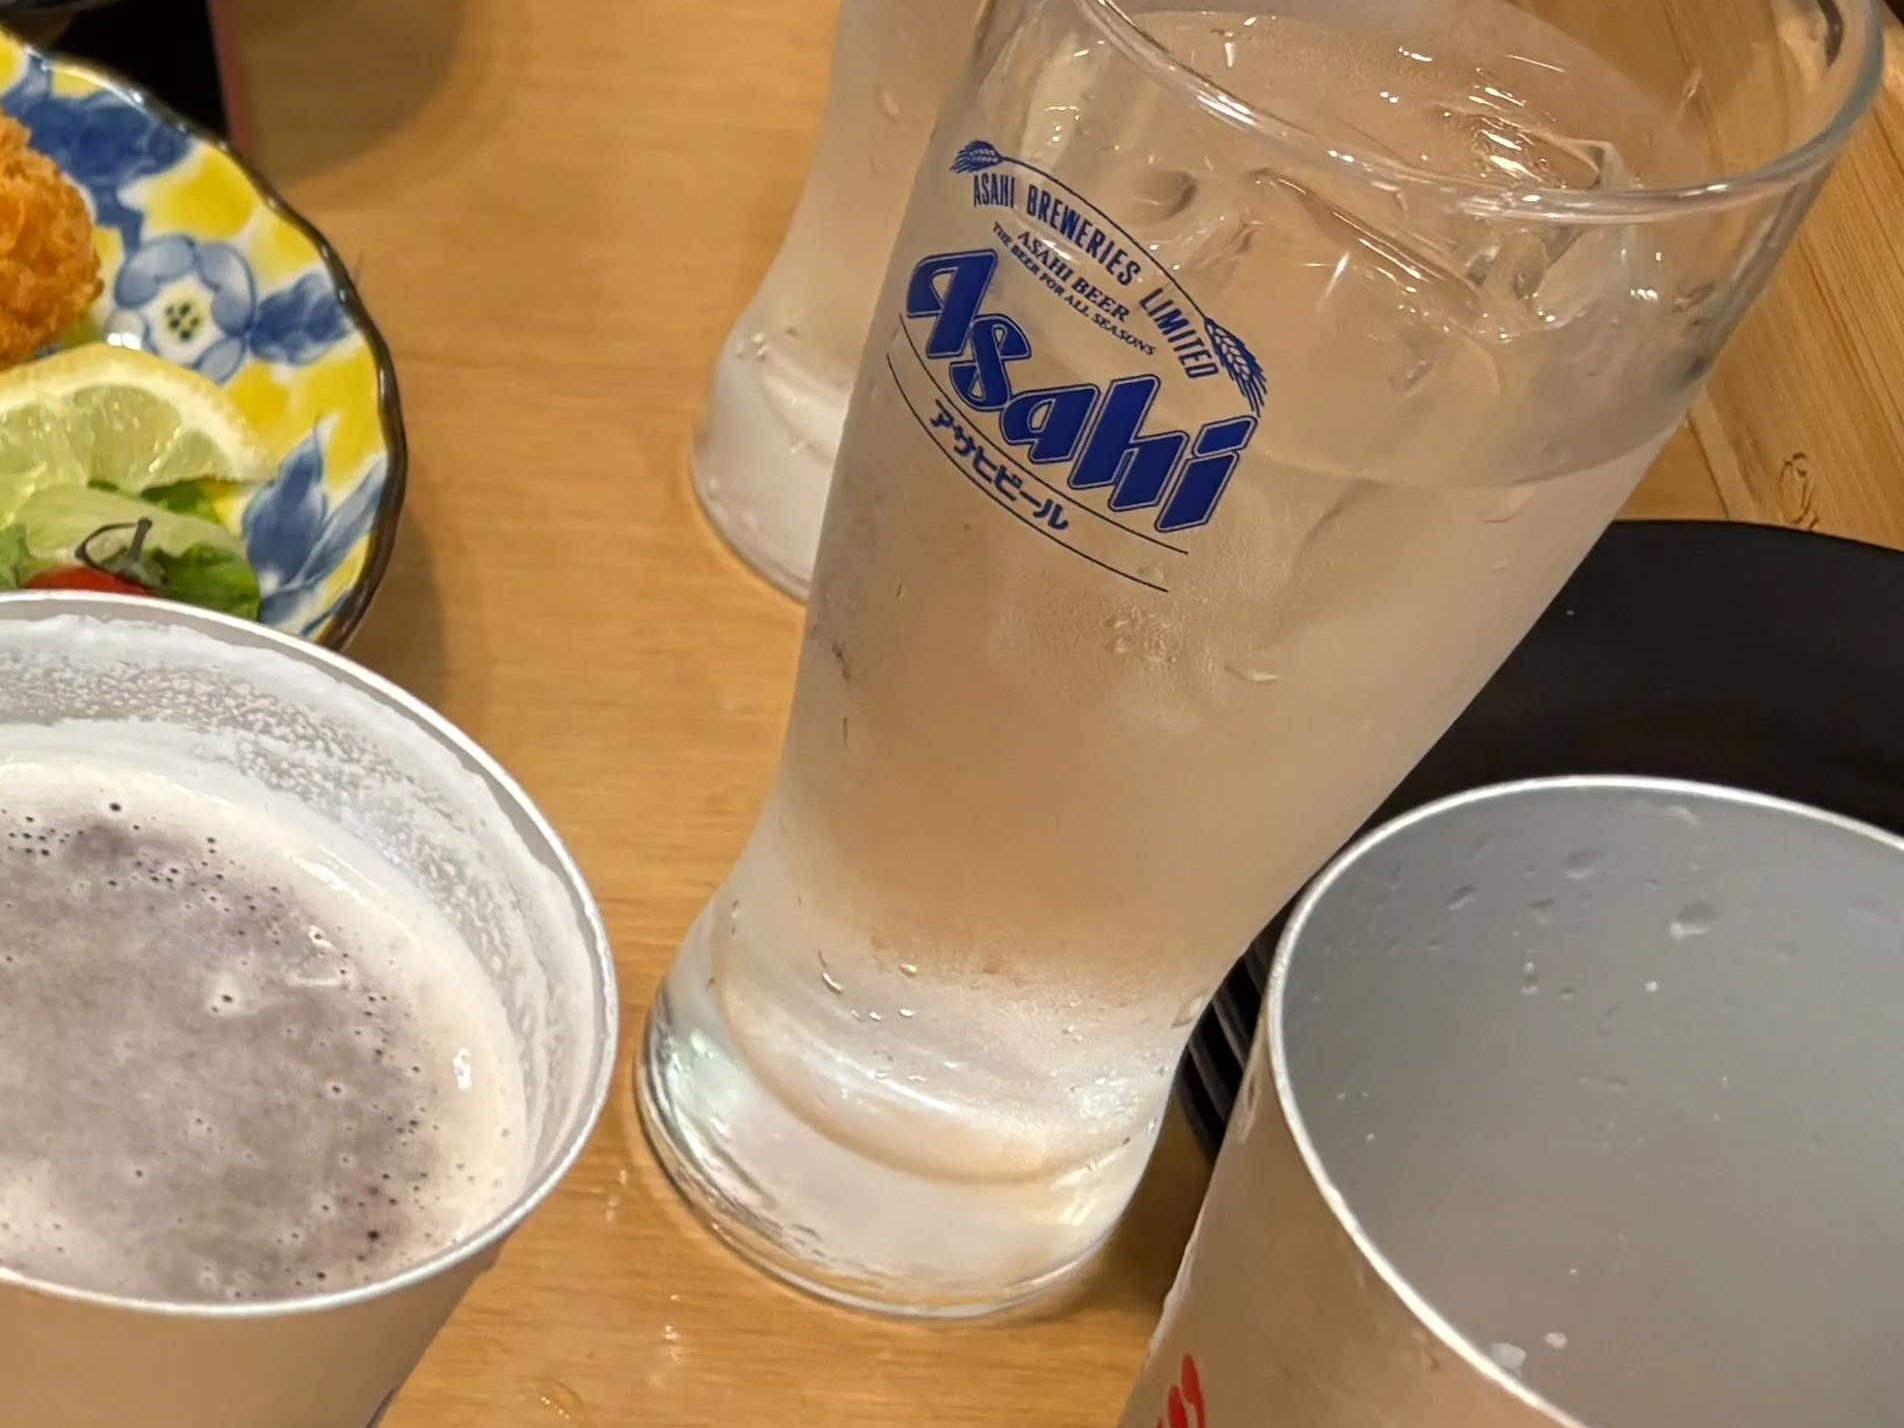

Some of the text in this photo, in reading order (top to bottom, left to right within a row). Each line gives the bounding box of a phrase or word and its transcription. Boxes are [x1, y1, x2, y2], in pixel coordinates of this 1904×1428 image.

[973, 172, 1220, 379] ASAHI BREWERIES LIMITED
[992, 221, 1157, 356] THE BEER FOR ALL SEASONS
[1017, 230, 1131, 323] ASAHI BEER
[906, 248, 1259, 534] Asahi
[929, 397, 1070, 531] アサヒビール
